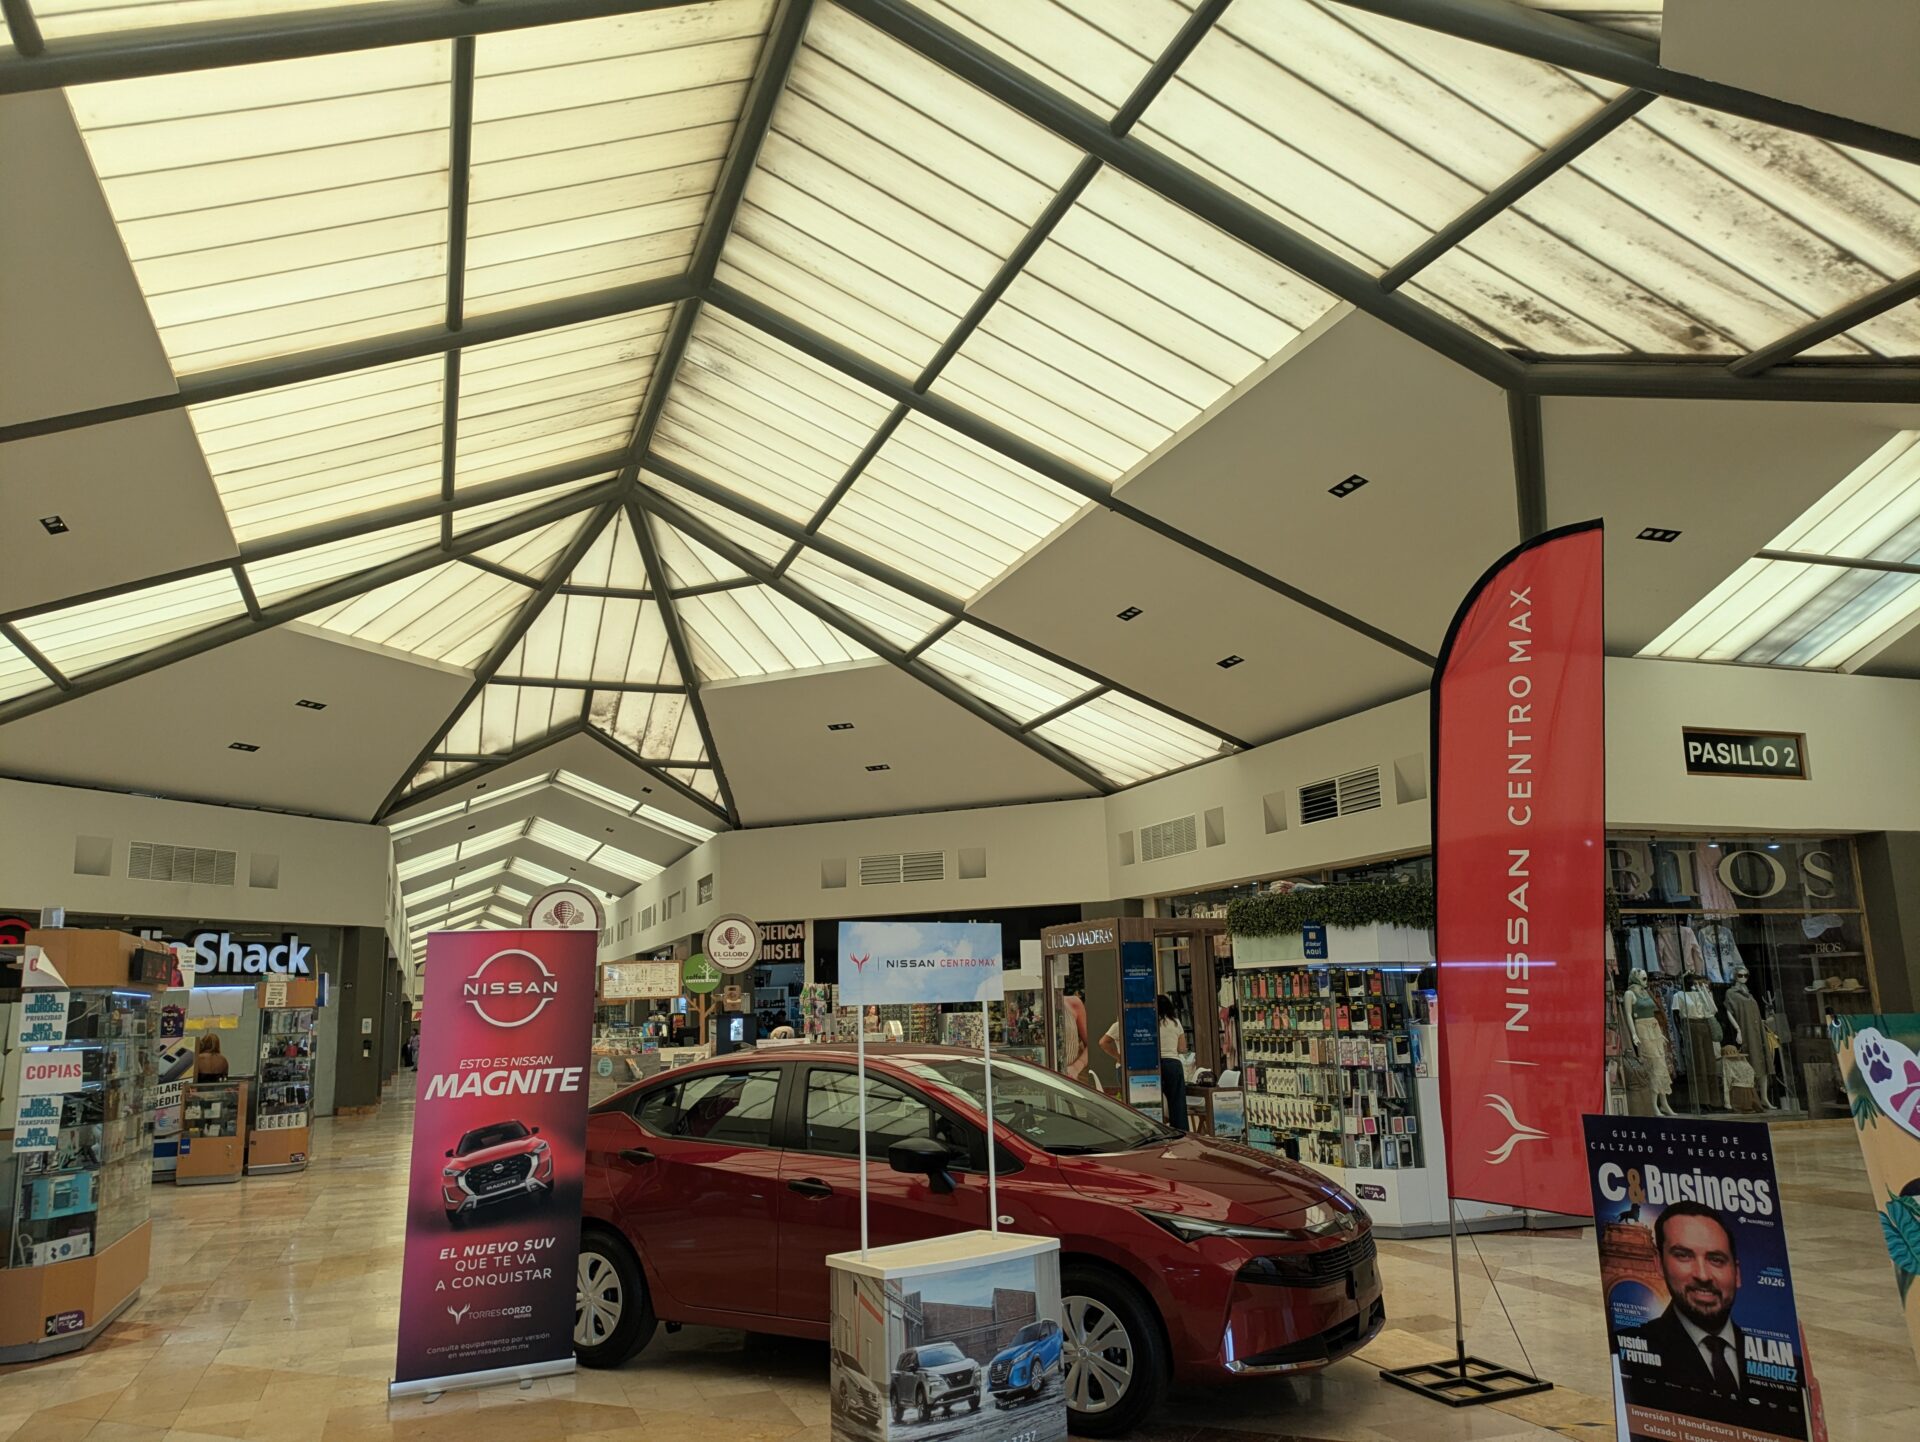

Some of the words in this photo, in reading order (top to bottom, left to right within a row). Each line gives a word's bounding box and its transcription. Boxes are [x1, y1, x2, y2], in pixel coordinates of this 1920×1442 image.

[1508, 586, 1531, 662] MAX
[1508, 675, 1531, 826] CENTRO
[1688, 741, 1779, 767] PASILLO
[1783, 747, 1796, 768] 2
[1046, 933, 1075, 949] CIUDAD
[1077, 928, 1113, 946] MADERAS
[1506, 849, 1529, 1032] NISSAN
[141, 930, 311, 974] Shack
[887, 959, 935, 968] NISSAN
[940, 959, 976, 968] CENTRO
[979, 958, 996, 967] MAX
[464, 981, 558, 996] NISSAN
[35, 994, 56, 1004] MICA
[32, 1023, 53, 1032] MICA
[459, 1058, 490, 1070] ESTO
[493, 1057, 508, 1068] ES
[510, 1055, 553, 1067] NISSAN
[26, 1064, 82, 1080] COPIAS
[424, 1067, 583, 1101] MAGNITE
[1612, 1129, 1647, 1140] GUIA
[1661, 1132, 1707, 1143] ELITE
[1722, 1136, 1739, 1145] DE
[1590, 1142, 1653, 1153] CALZADO
[1667, 1147, 1674, 1155] &
[1688, 1148, 1768, 1161] NEGOCIOS
[486, 1178, 518, 1191] MAGNITE
[440, 1248, 458, 1260] EL
[463, 1241, 519, 1257] NUEVO
[523, 1237, 556, 1251] SUV
[455, 1257, 487, 1272] QUE
[494, 1255, 511, 1267] TE
[517, 1253, 536, 1265] VA
[435, 1280, 446, 1292] A
[451, 1268, 552, 1289] CONQUISTAR
[1757, 1275, 1785, 1288] 2026
[501, 1305, 532, 1316] CORZO
[426, 1343, 459, 1354] Consulta
[460, 1337, 509, 1349] equipamiento
[511, 1336, 523, 1344] por
[524, 1332, 550, 1341] versión
[458, 1343, 529, 1358] www.nissan.com.mx
[1617, 1335, 1648, 1352] VISIÓN
[1744, 1335, 1795, 1367] ALAN
[1626, 1349, 1662, 1367] FUTURO
[1631, 1408, 1670, 1423] Inversión
[1677, 1418, 1734, 1437] Manufactura
[1643, 1424, 1677, 1438] Calzado
